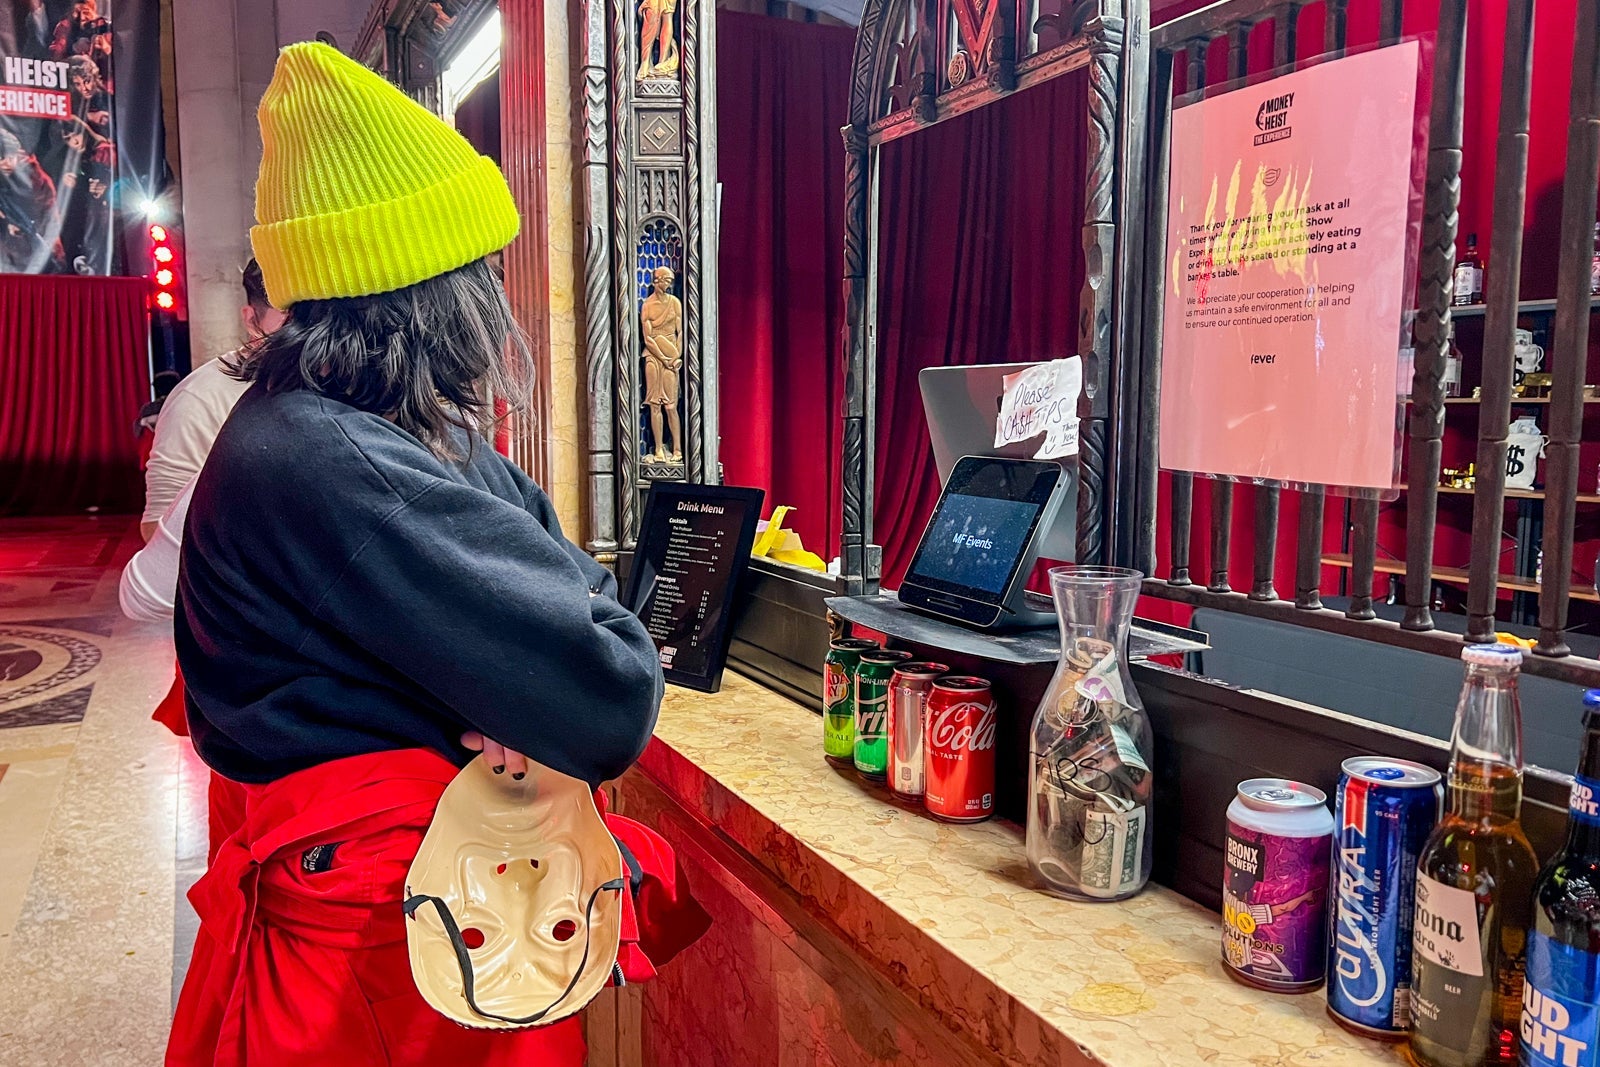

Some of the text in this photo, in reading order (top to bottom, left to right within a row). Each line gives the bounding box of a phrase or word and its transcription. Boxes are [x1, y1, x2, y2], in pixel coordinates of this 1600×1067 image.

[5, 56, 69, 89] HEIST
[1266, 92, 1295, 114] MONEY
[1265, 111, 1287, 130] HEIST
[1190, 198, 1350, 233] Thank you for wearing your mask at all
[1189, 236, 1206, 246] times
[1268, 224, 1282, 233] the
[1284, 220, 1303, 230] Post
[1305, 216, 1333, 227] Show
[1256, 239, 1271, 249] you
[1273, 236, 1286, 246] are
[1288, 230, 1325, 243] actively
[1327, 226, 1361, 238] eating
[1251, 249, 1278, 261] seated
[1292, 243, 1334, 255] standing
[1336, 242, 1347, 250] at
[1350, 241, 1357, 249] a
[1218, 269, 1239, 278] table.
[1187, 283, 1355, 306] We appreciate your cooperation in helping
[1193, 306, 1226, 316] maintain
[1234, 304, 1250, 313] safe
[1251, 301, 1302, 312] environment
[1304, 298, 1316, 308] for
[1318, 297, 1329, 307] all
[1331, 296, 1351, 306] and
[1192, 319, 1216, 328] ensure
[1218, 319, 1231, 327] our
[1233, 315, 1272, 326] continued
[1274, 312, 1315, 324] operation.
[1250, 354, 1276, 364] fever
[1013, 383, 1052, 410] Please
[677, 501, 724, 515] Drink Menu
[953, 533, 993, 550] MF Events
[1228, 837, 1258, 864] BRONX
[1228, 852, 1258, 875] BREWERY
[1224, 902, 1256, 934] NO
[1522, 975, 1570, 1031] UD
